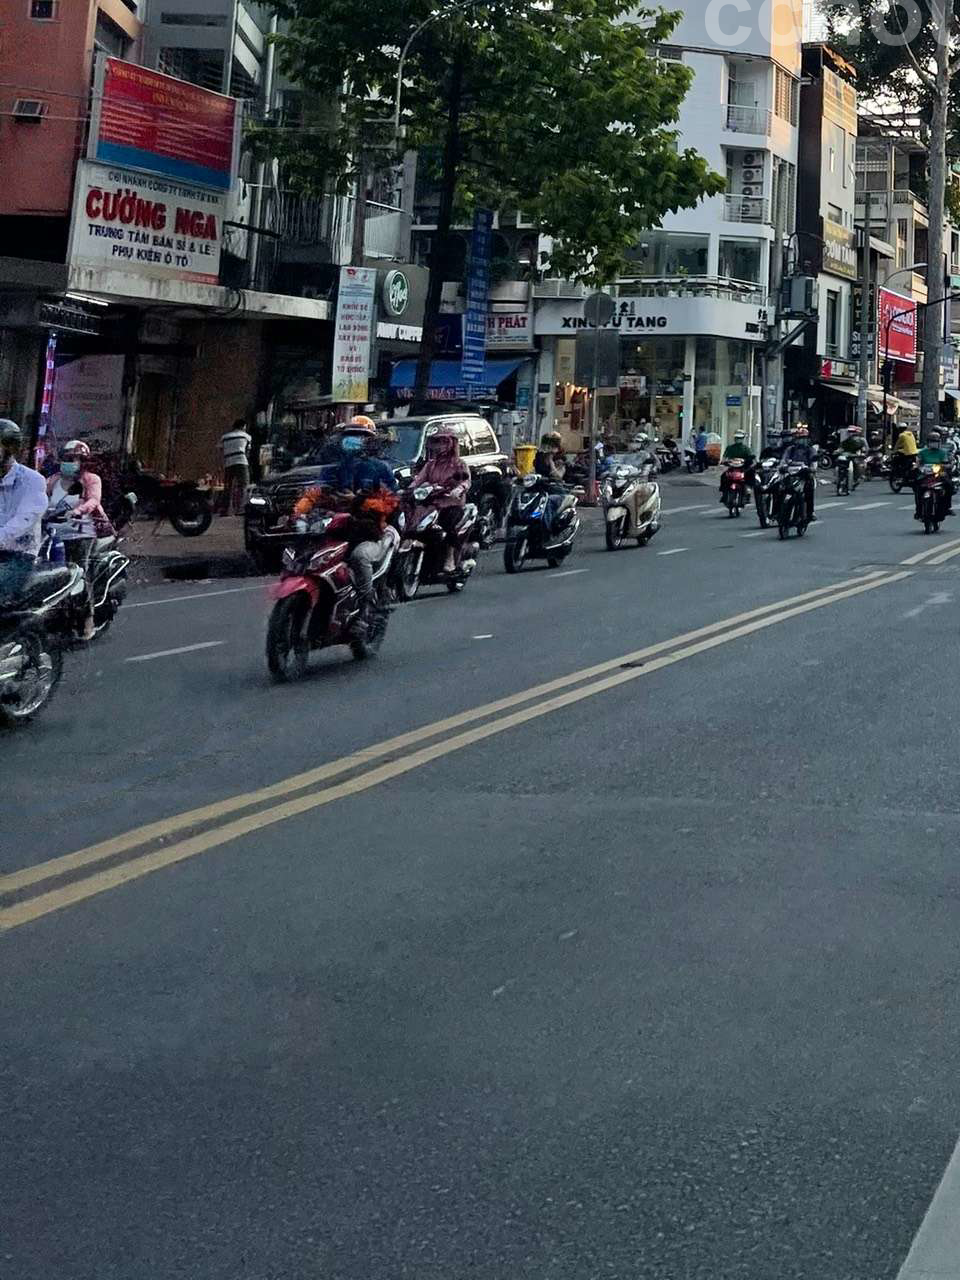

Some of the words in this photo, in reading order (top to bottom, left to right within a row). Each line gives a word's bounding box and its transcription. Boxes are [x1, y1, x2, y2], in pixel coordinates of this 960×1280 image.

[86, 188, 167, 231] CƯỜNG
[174, 207, 217, 240] NGA
[88, 223, 125, 240] TRUNG
[627, 316, 668, 328] TANG
